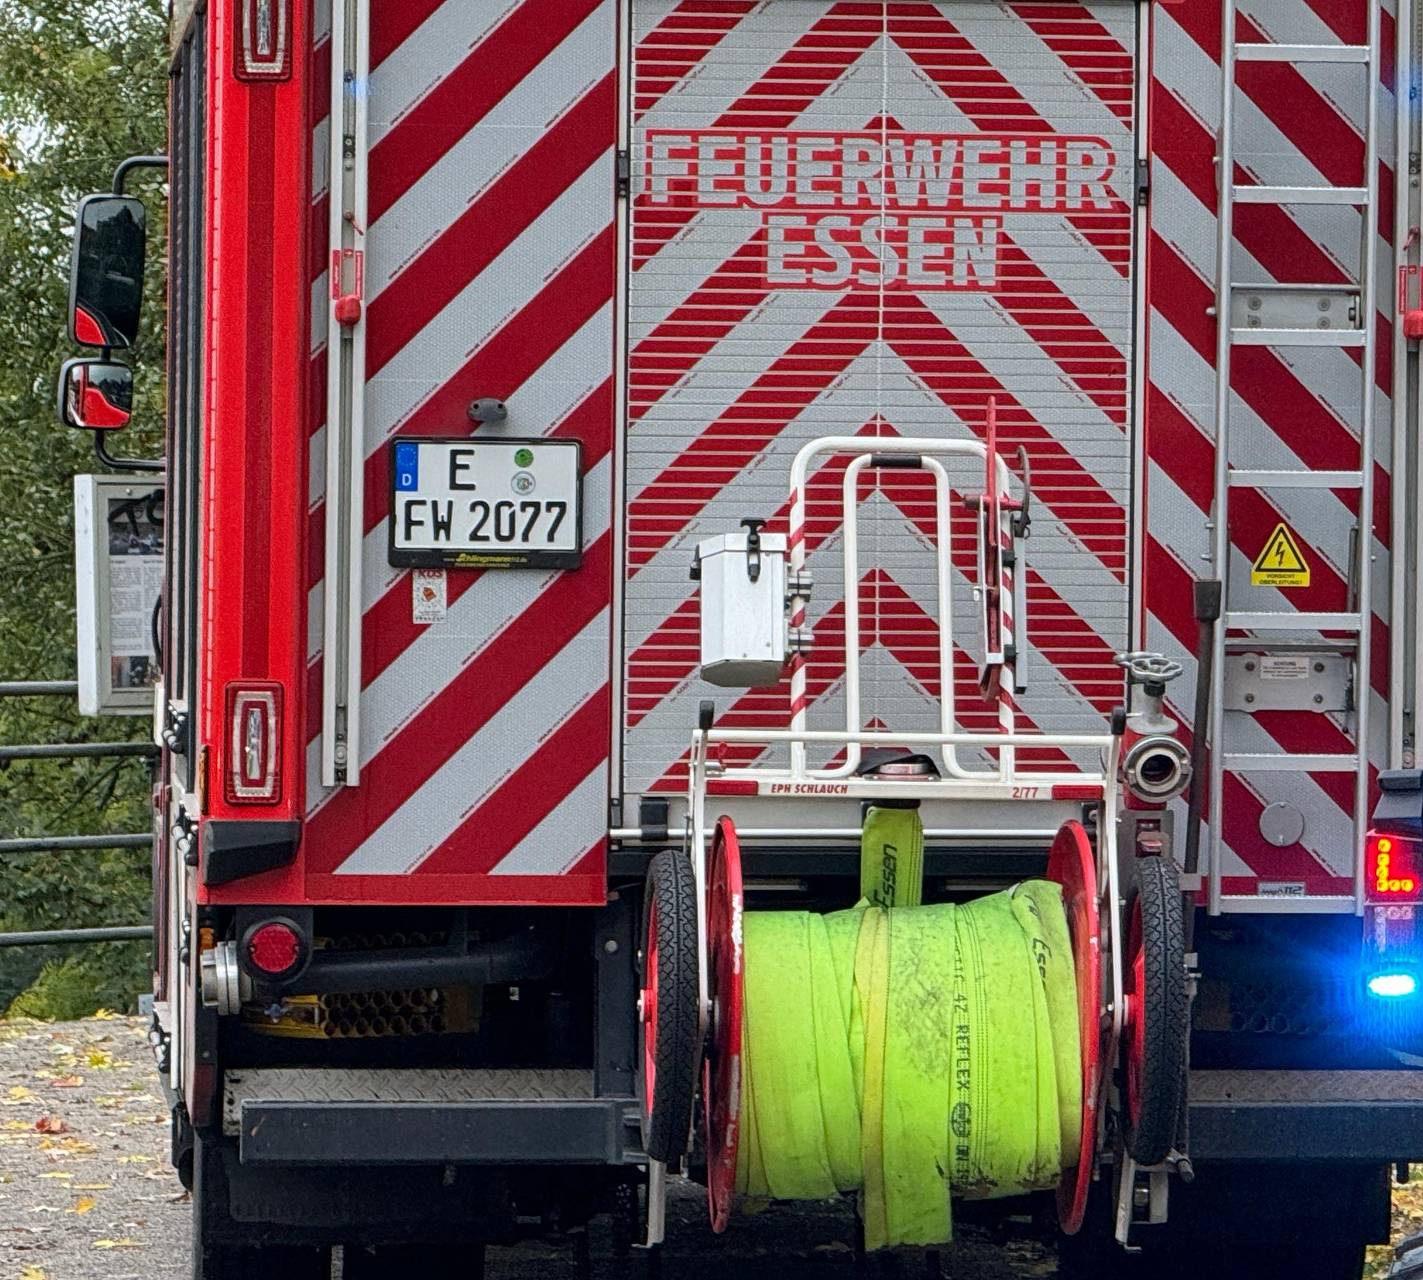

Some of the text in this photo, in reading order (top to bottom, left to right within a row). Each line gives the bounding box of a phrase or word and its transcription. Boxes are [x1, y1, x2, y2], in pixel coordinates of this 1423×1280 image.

[651, 135, 1114, 210] FEUERWEHR
[765, 214, 998, 286] ESSEN
[402, 474, 412, 486] D
[449, 449, 476, 491] E
[404, 500, 567, 543] FW 2077
[771, 784, 848, 794] EPH SCHLAUCH
[1012, 787, 1039, 798] 2/77
[956, 1024, 971, 1090] REFLEX
